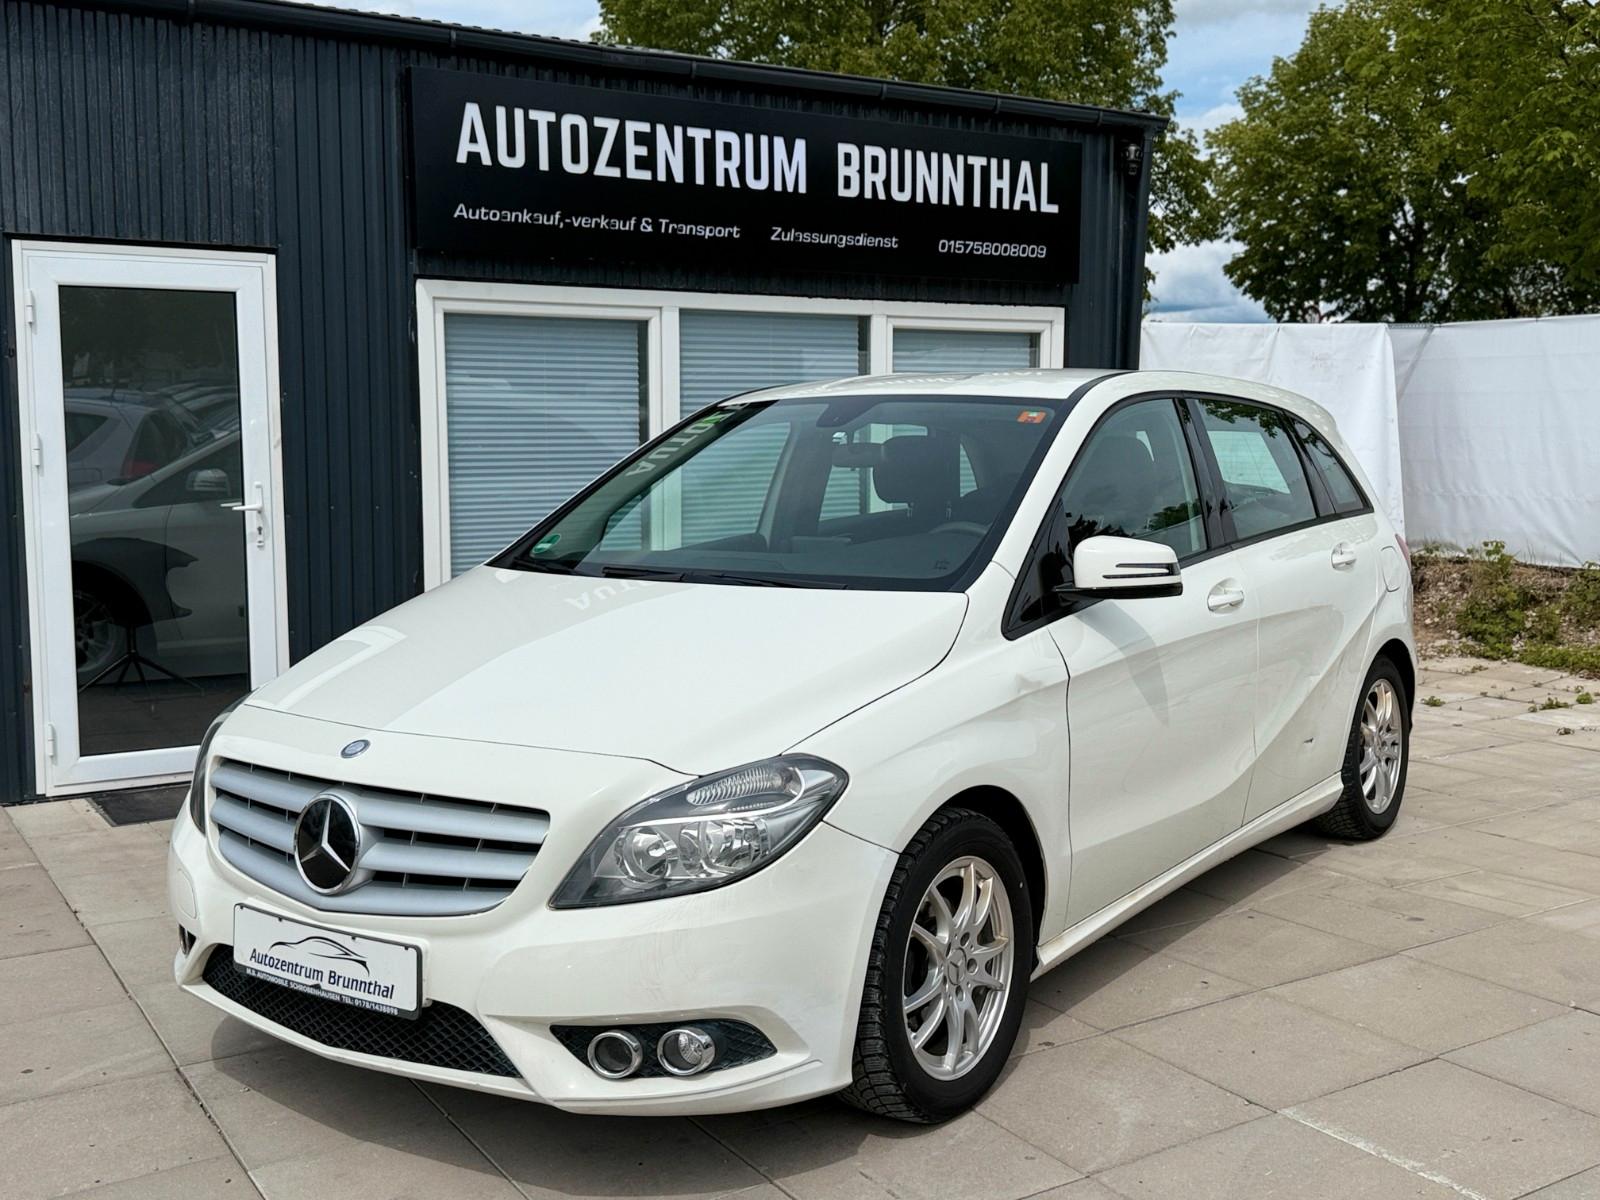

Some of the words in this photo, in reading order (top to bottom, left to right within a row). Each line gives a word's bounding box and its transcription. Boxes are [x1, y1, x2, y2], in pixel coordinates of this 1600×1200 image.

[456, 101, 808, 195] AUTOZENTRUM
[837, 142, 1060, 214] BRUNNTHAL
[453, 203, 637, 231] Autoankauf,-verkauf
[640, 217, 653, 232] &
[658, 218, 741, 239] Transport
[770, 226, 899, 248] Zulassungsdienst
[938, 239, 1047, 258] 015758008009
[249, 948, 324, 983] Autozentrum
[328, 970, 395, 1000] Brunnthal
